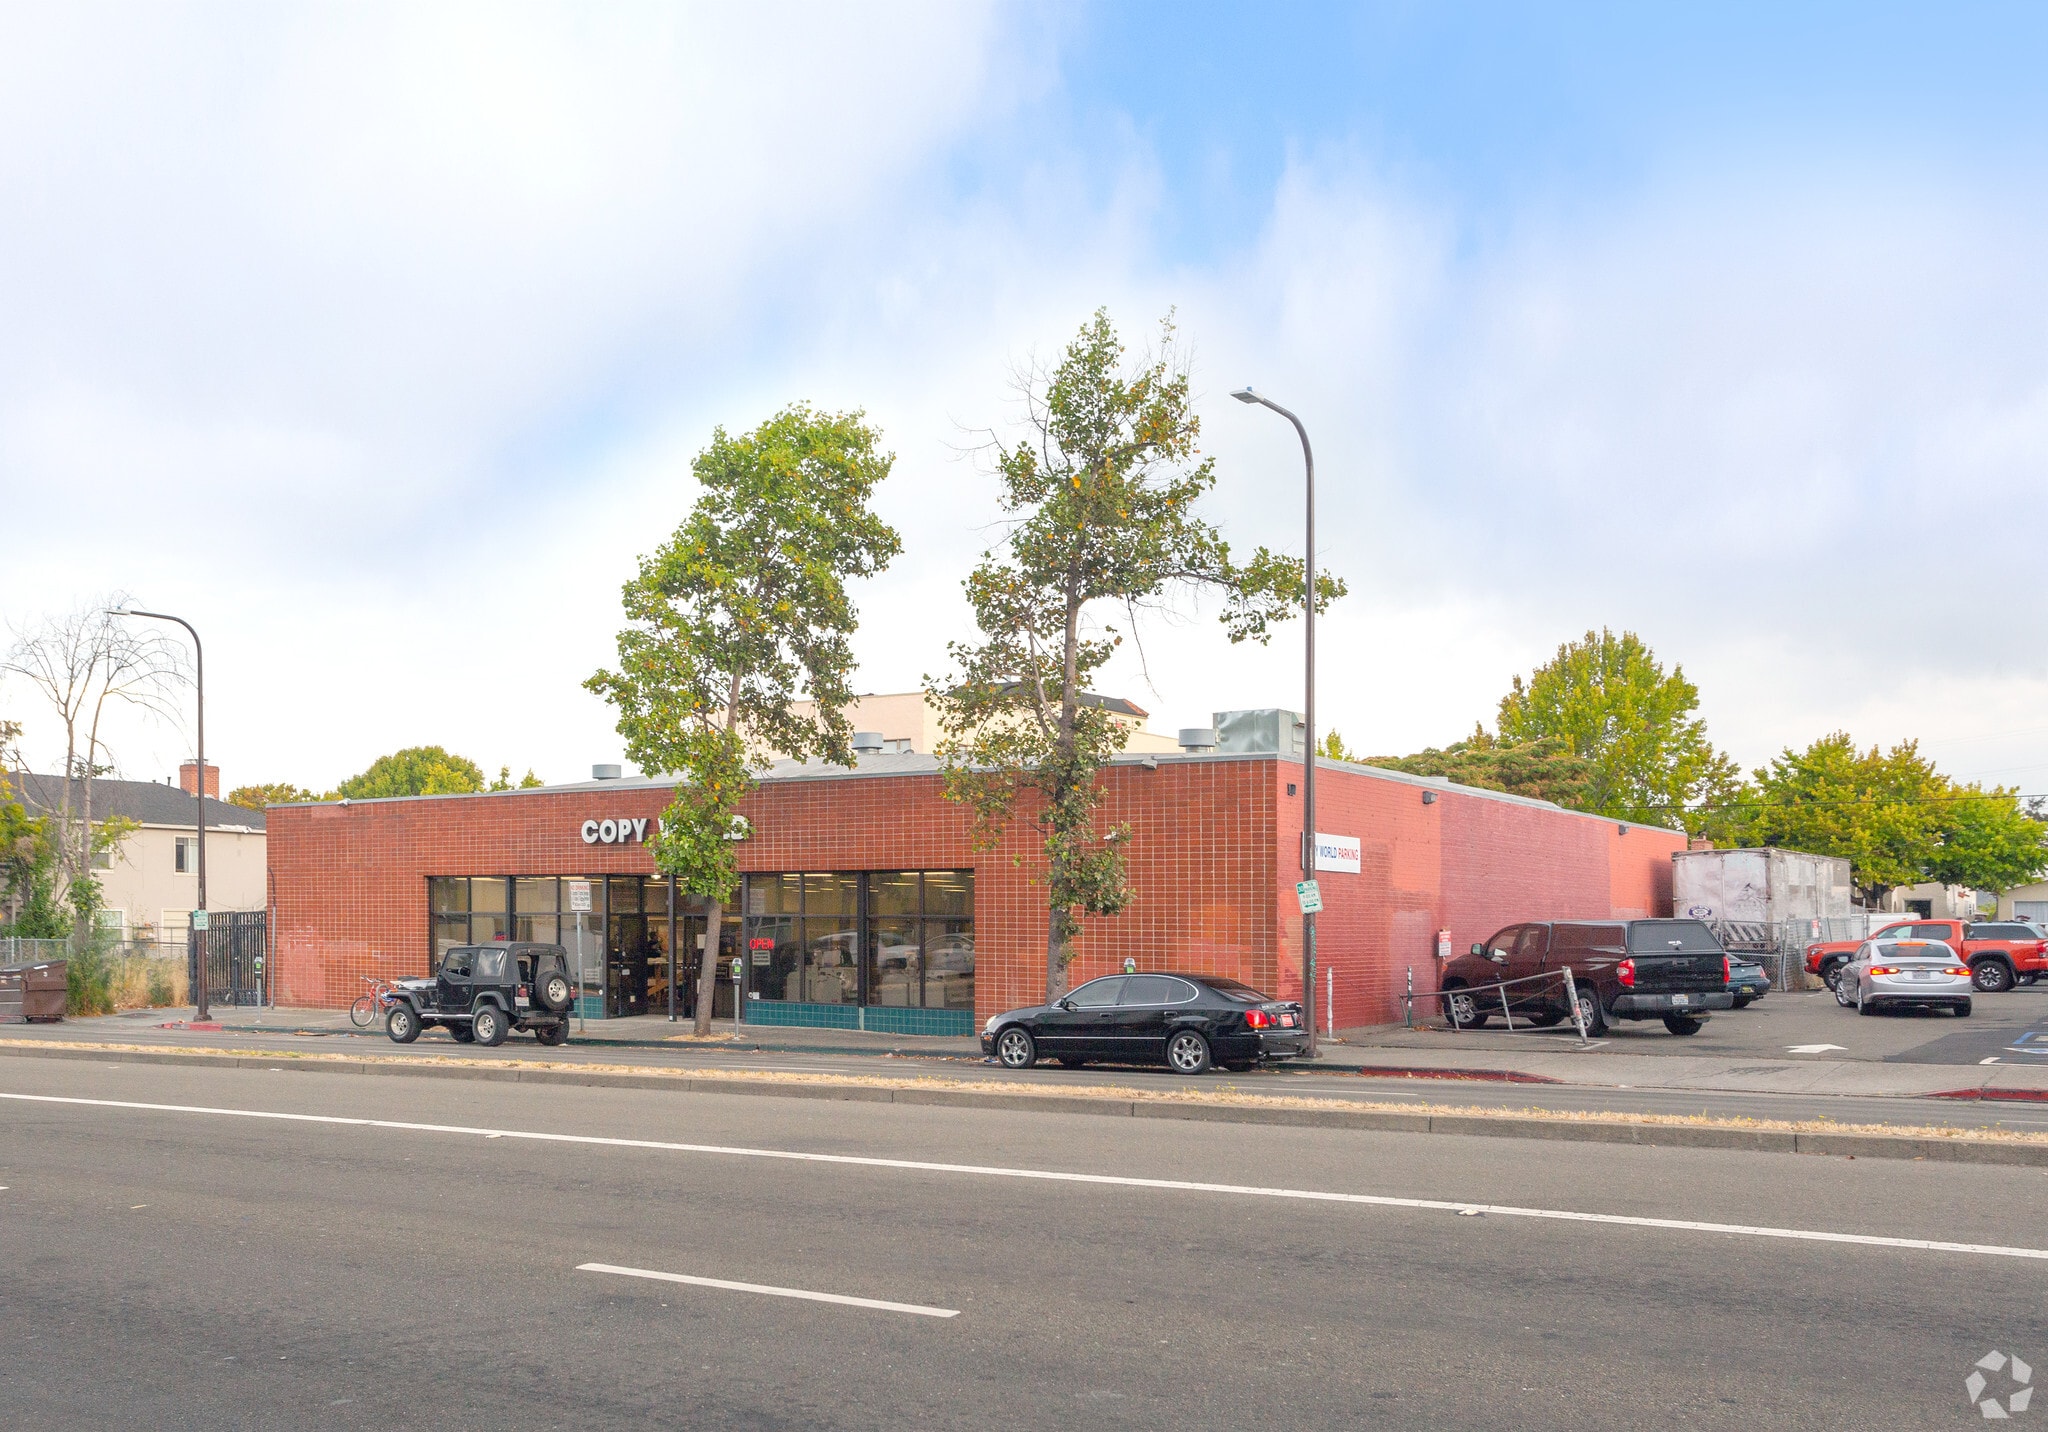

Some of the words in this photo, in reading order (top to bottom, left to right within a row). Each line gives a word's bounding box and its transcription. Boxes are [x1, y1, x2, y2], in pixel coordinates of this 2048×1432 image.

[581, 818, 647, 843] COPY
[1320, 846, 1337, 858] WORLD
[1338, 847, 1358, 860] PARKING
[749, 938, 775, 950] OPEN
